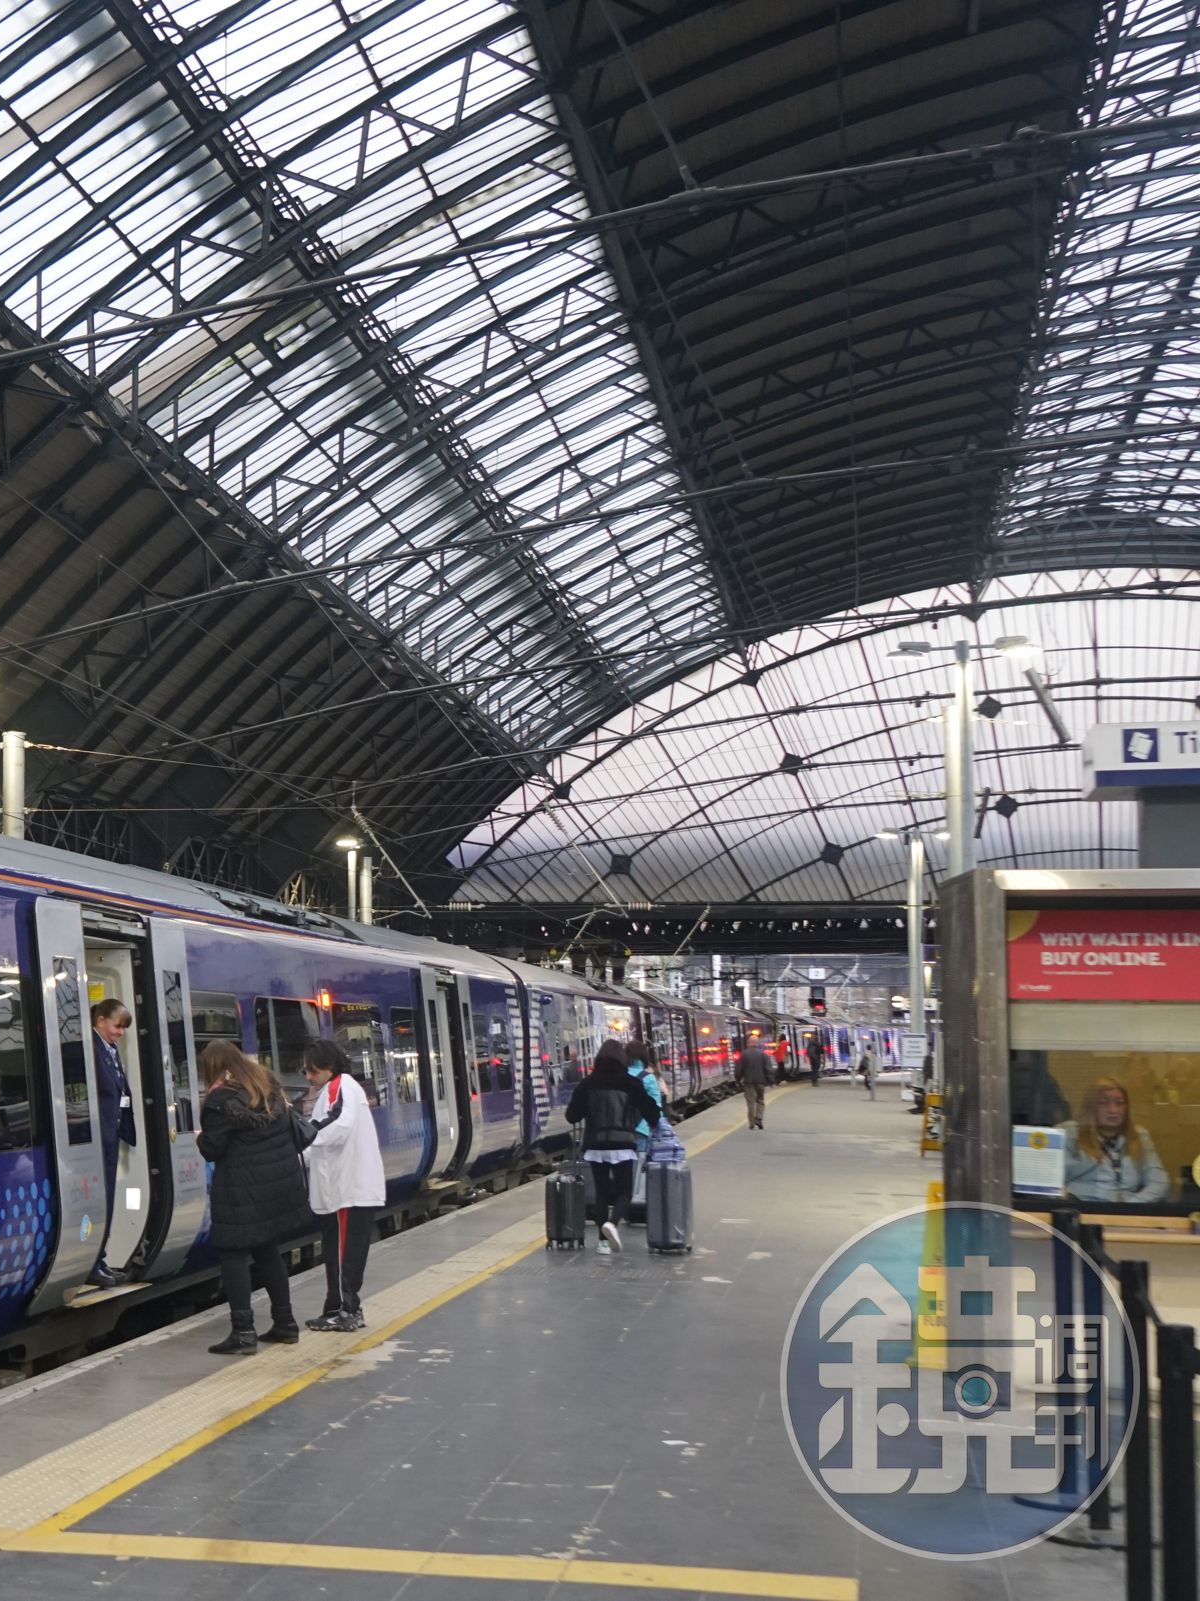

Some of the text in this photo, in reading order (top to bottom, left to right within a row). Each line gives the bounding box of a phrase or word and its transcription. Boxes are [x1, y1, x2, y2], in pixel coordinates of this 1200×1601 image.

[1174, 730, 1198, 754] Ti
[1040, 932, 1086, 946] WHY
[1089, 932, 1140, 946] WAIT
[1143, 932, 1168, 946] IN
[1041, 951, 1166, 966] BUY ONLINE.
